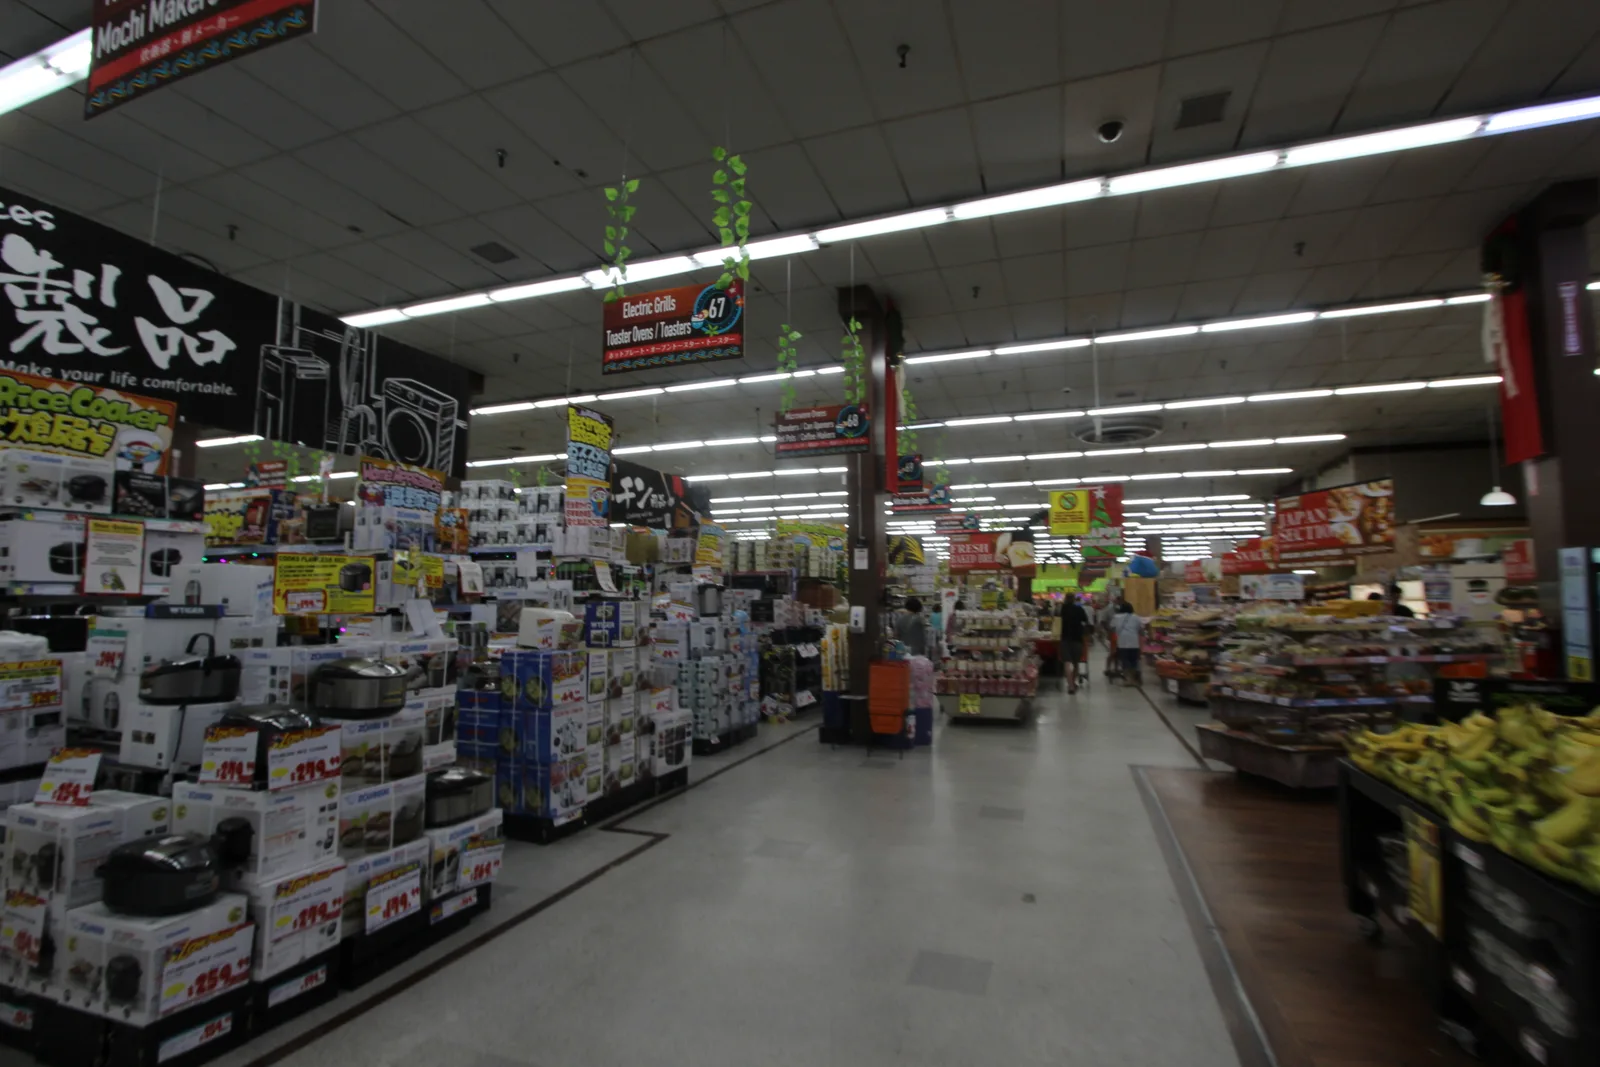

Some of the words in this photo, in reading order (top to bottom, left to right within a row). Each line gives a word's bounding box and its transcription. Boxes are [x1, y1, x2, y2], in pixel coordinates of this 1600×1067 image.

[96, 4, 147, 59] Mochi
[0, 233, 237, 370] 製品
[622, 299, 653, 319] Electric
[653, 295, 677, 313] Grills
[708, 297, 726, 319] 67
[606, 329, 632, 347] Toaster
[632, 324, 654, 343] Ovens
[659, 318, 692, 338] Toasters
[61, 364, 105, 387] your
[109, 368, 138, 388] life
[0, 375, 71, 414] Rice
[69, 386, 170, 432] Cooker
[847, 413, 859, 428] 68
